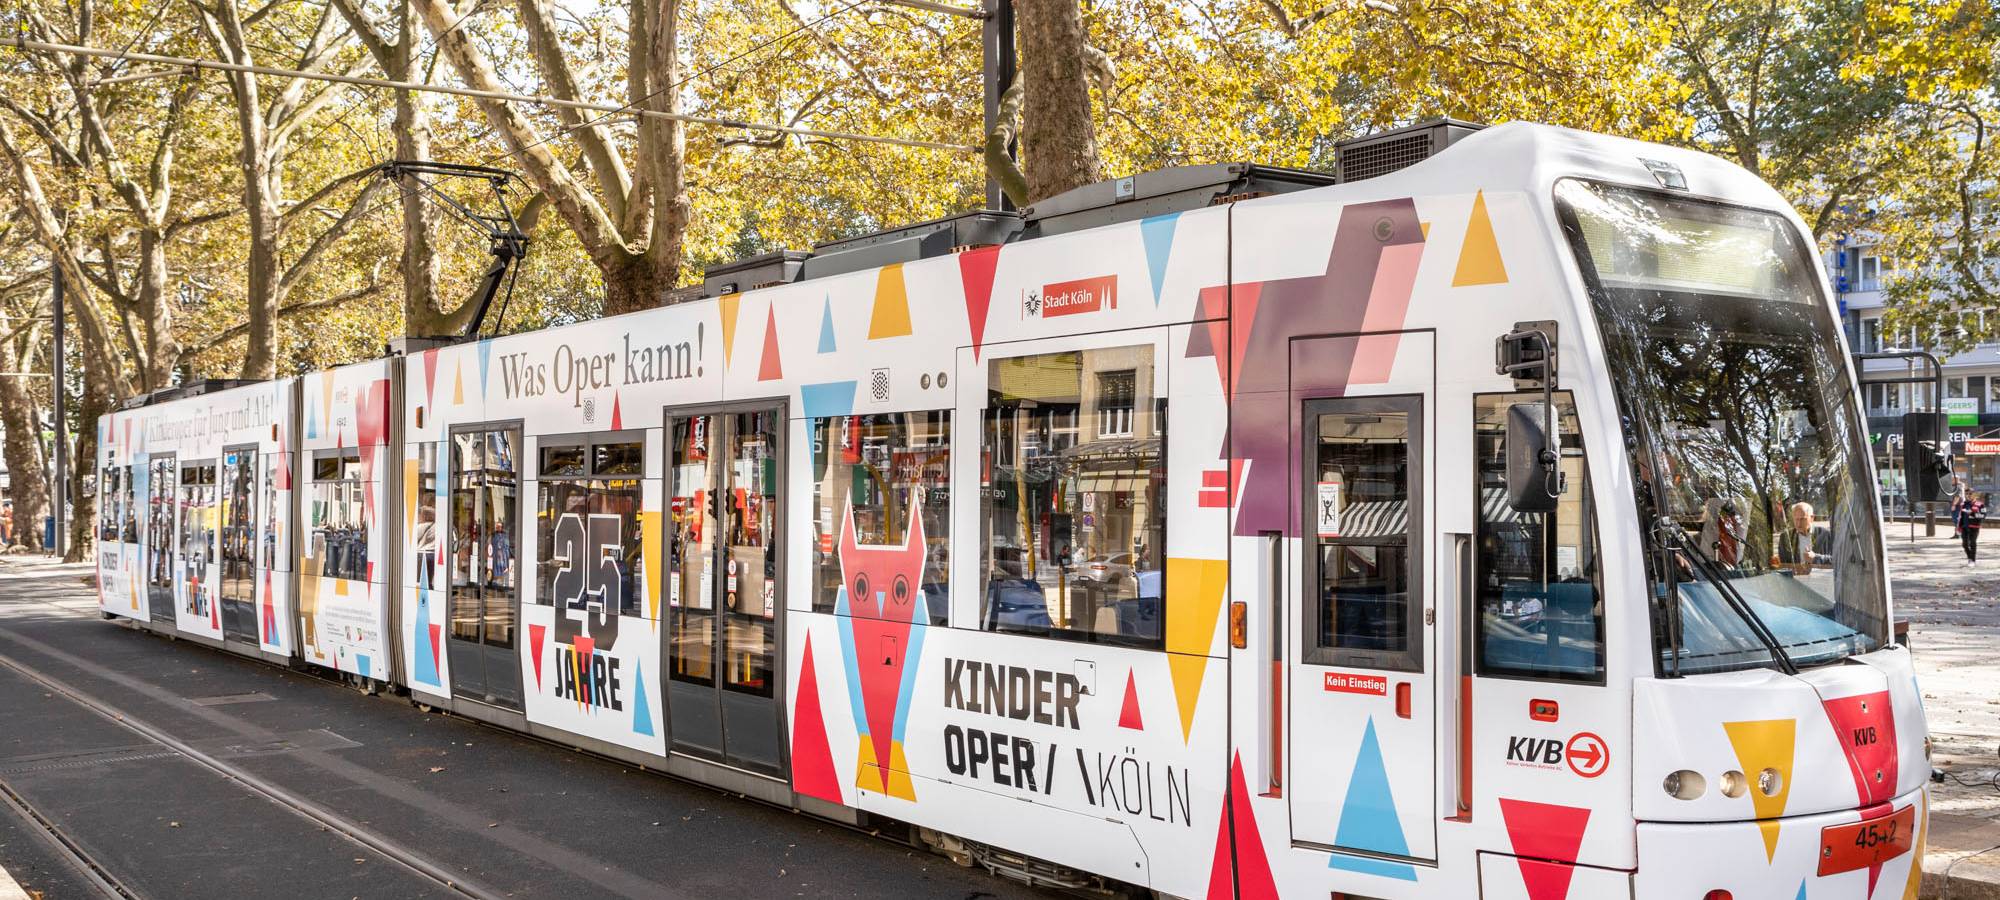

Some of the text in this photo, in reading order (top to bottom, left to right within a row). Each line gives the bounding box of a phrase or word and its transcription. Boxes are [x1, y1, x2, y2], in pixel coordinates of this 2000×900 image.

[1044, 288, 1093, 309] Stadt Köln
[500, 321, 704, 408] Was Oper kann!
[207, 405, 231, 445] Jung
[231, 397, 250, 431] und
[554, 513, 622, 652] 25
[555, 648, 623, 712] JAHRE
[944, 657, 1081, 731] KINDER
[1327, 675, 1385, 692] Kein Einstieg
[1507, 736, 1563, 764] KVB
[1854, 727, 1877, 747] KVB
